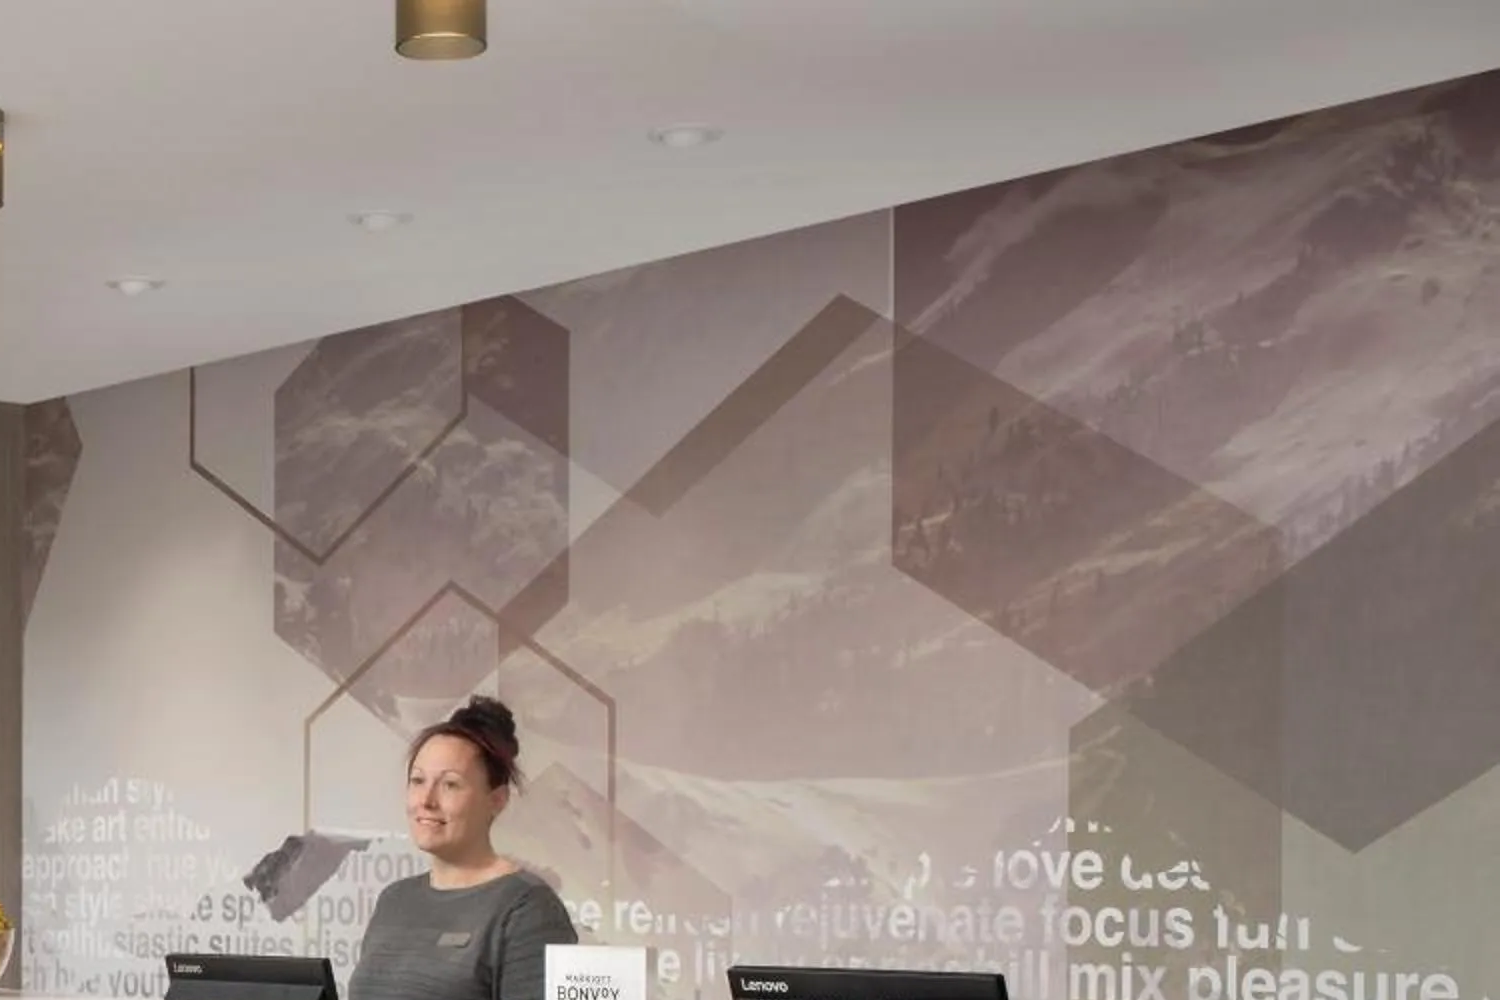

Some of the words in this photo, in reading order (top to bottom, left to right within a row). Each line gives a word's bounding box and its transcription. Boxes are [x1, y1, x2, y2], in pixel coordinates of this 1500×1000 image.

[92, 810, 127, 843] art
[1040, 893, 1195, 950] focus
[565, 974, 613, 984] MARRIOTT
[741, 977, 790, 993] Lenovo
